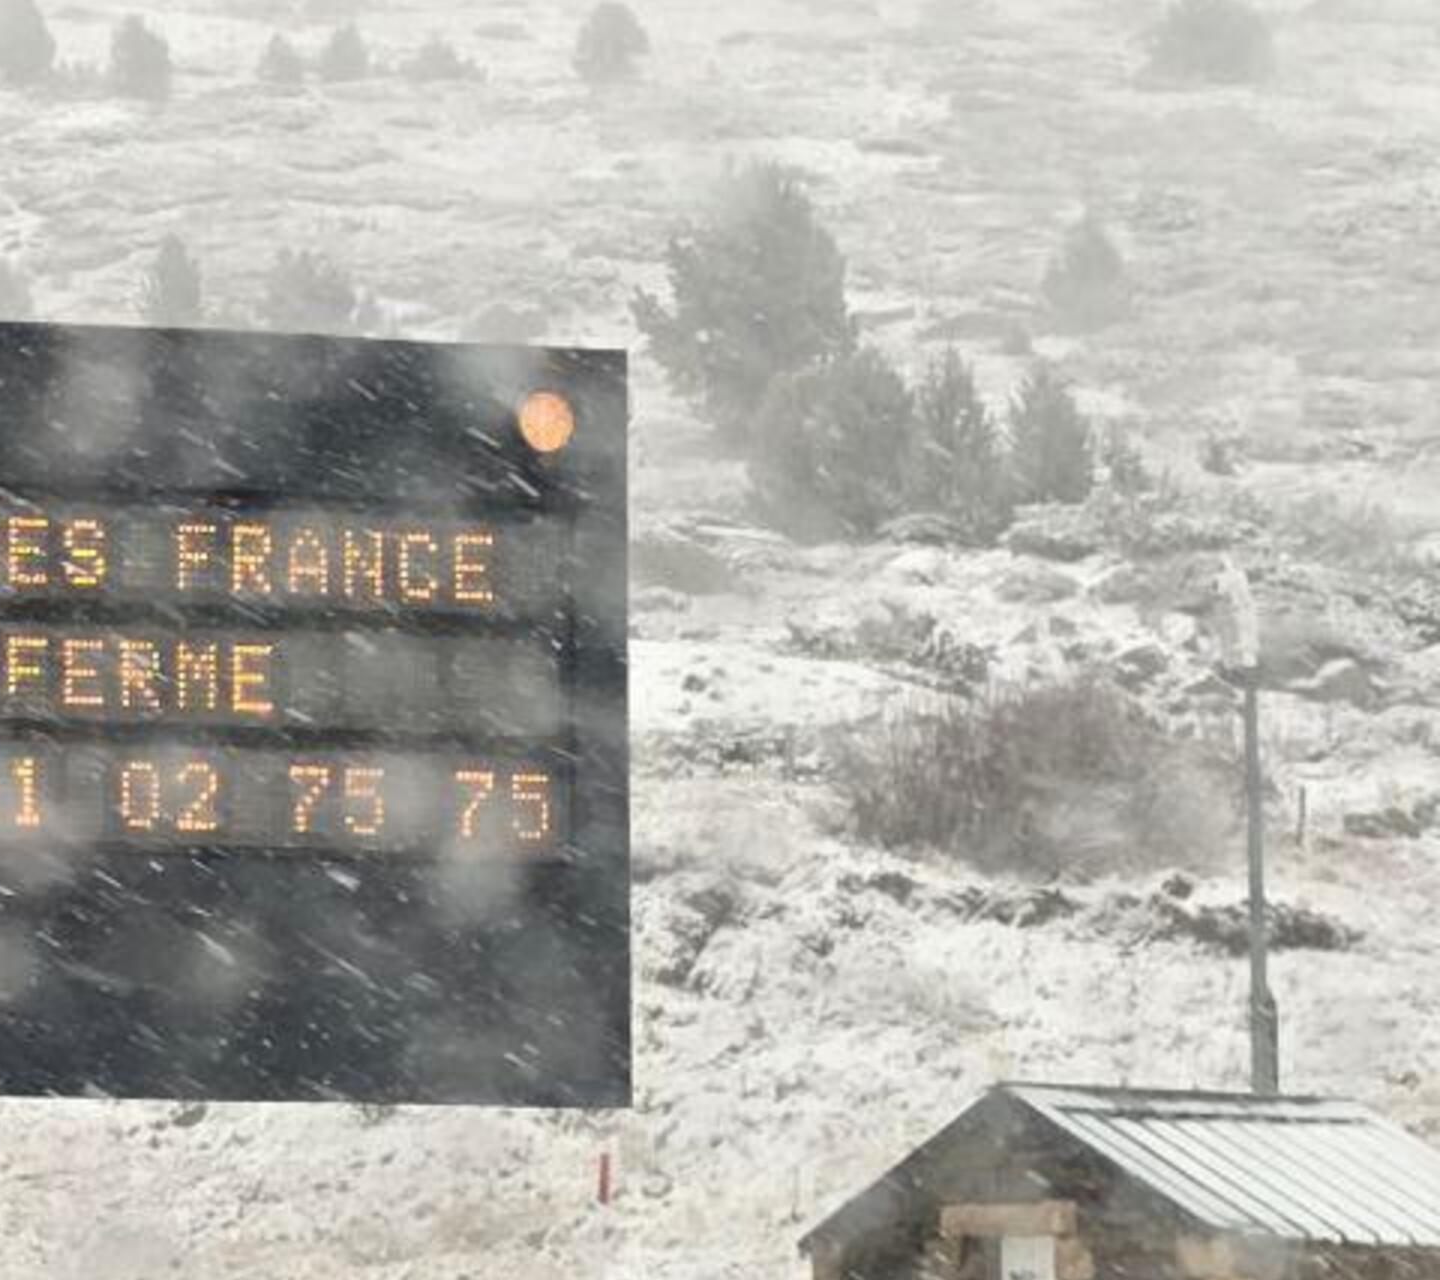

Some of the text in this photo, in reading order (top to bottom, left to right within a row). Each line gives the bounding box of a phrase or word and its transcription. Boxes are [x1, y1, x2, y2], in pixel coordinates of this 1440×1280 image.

[176, 522, 495, 602] FRANCE
[5, 634, 275, 714] FERME
[119, 759, 220, 832] 02
[288, 764, 386, 837] 75
[455, 768, 551, 840] 75
